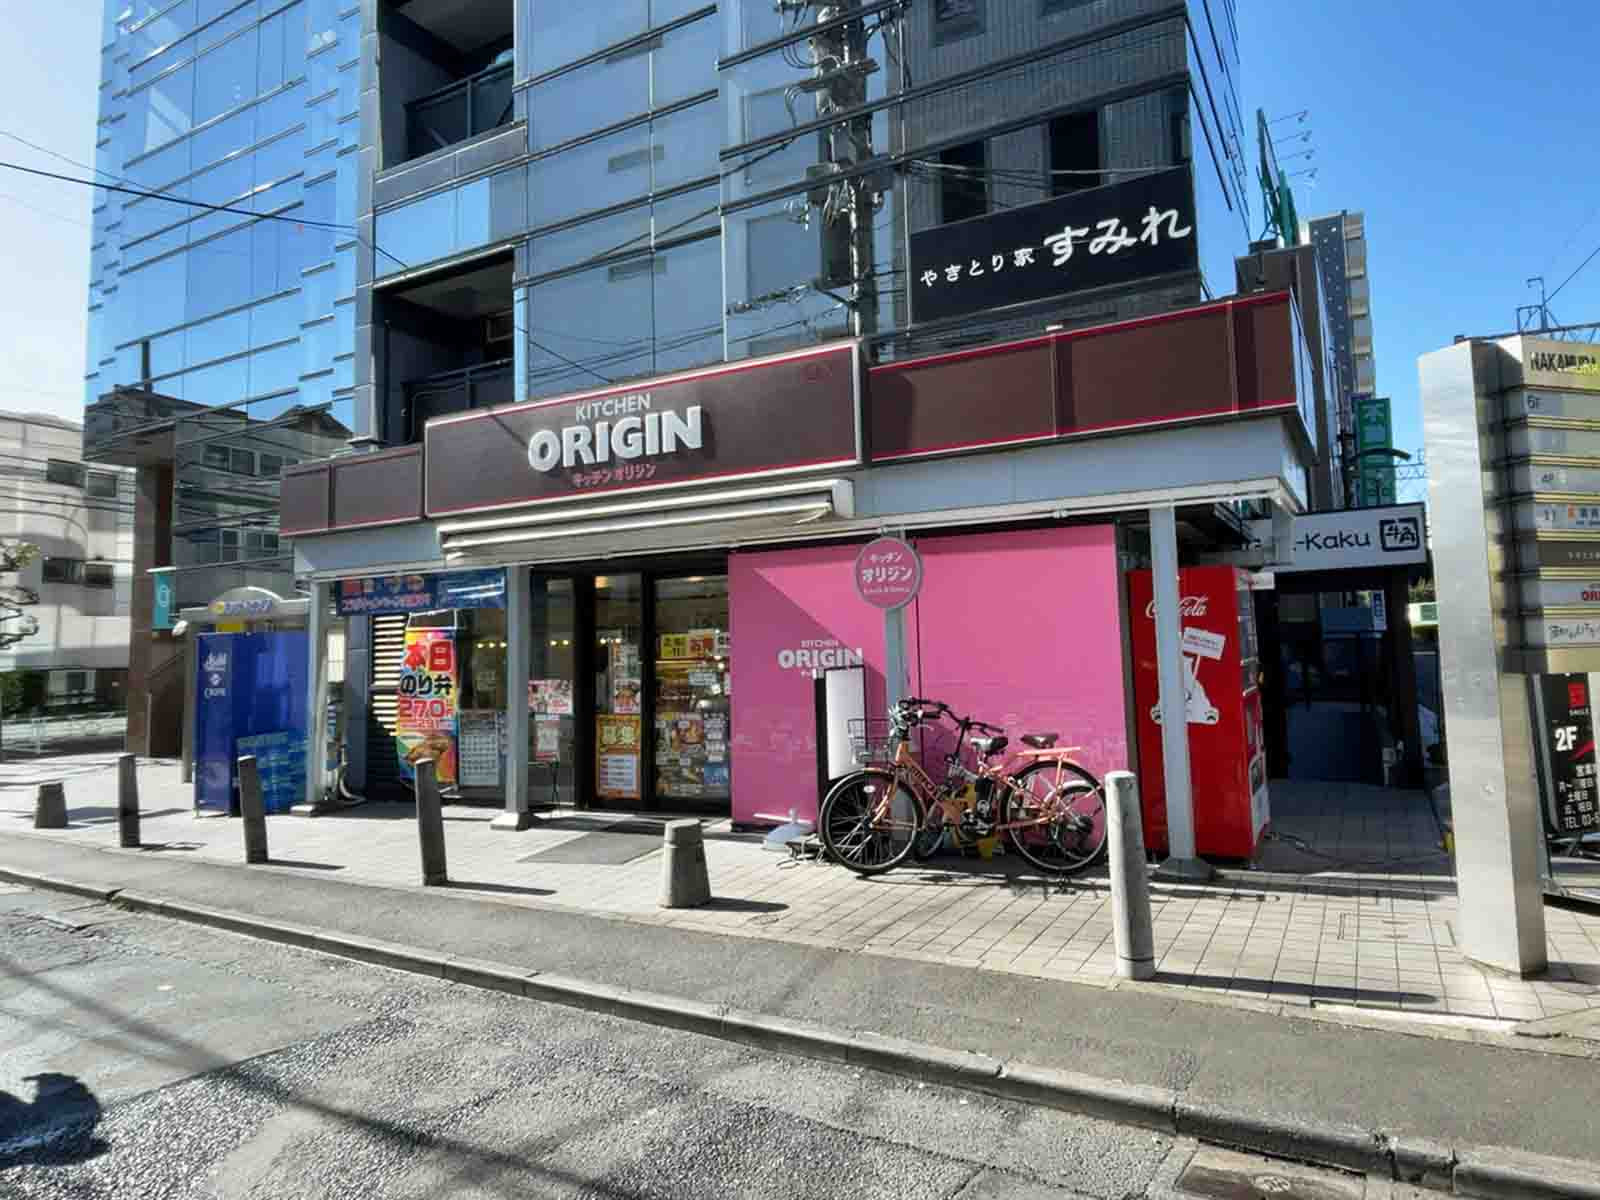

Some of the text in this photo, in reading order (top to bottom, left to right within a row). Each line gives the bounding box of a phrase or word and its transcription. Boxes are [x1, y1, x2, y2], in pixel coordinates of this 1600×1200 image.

[920, 205, 1192, 288] やきとり家 すみれ
[575, 393, 651, 424] KITCHEN
[527, 405, 703, 473] ORIGIN
[862, 567, 913, 583] オリジン
[404, 641, 452, 672] 本日
[778, 648, 863, 669] ORIGIN
[400, 674, 453, 696] のり弁
[398, 698, 446, 718] 270
[1554, 726, 1578, 752] 2F
